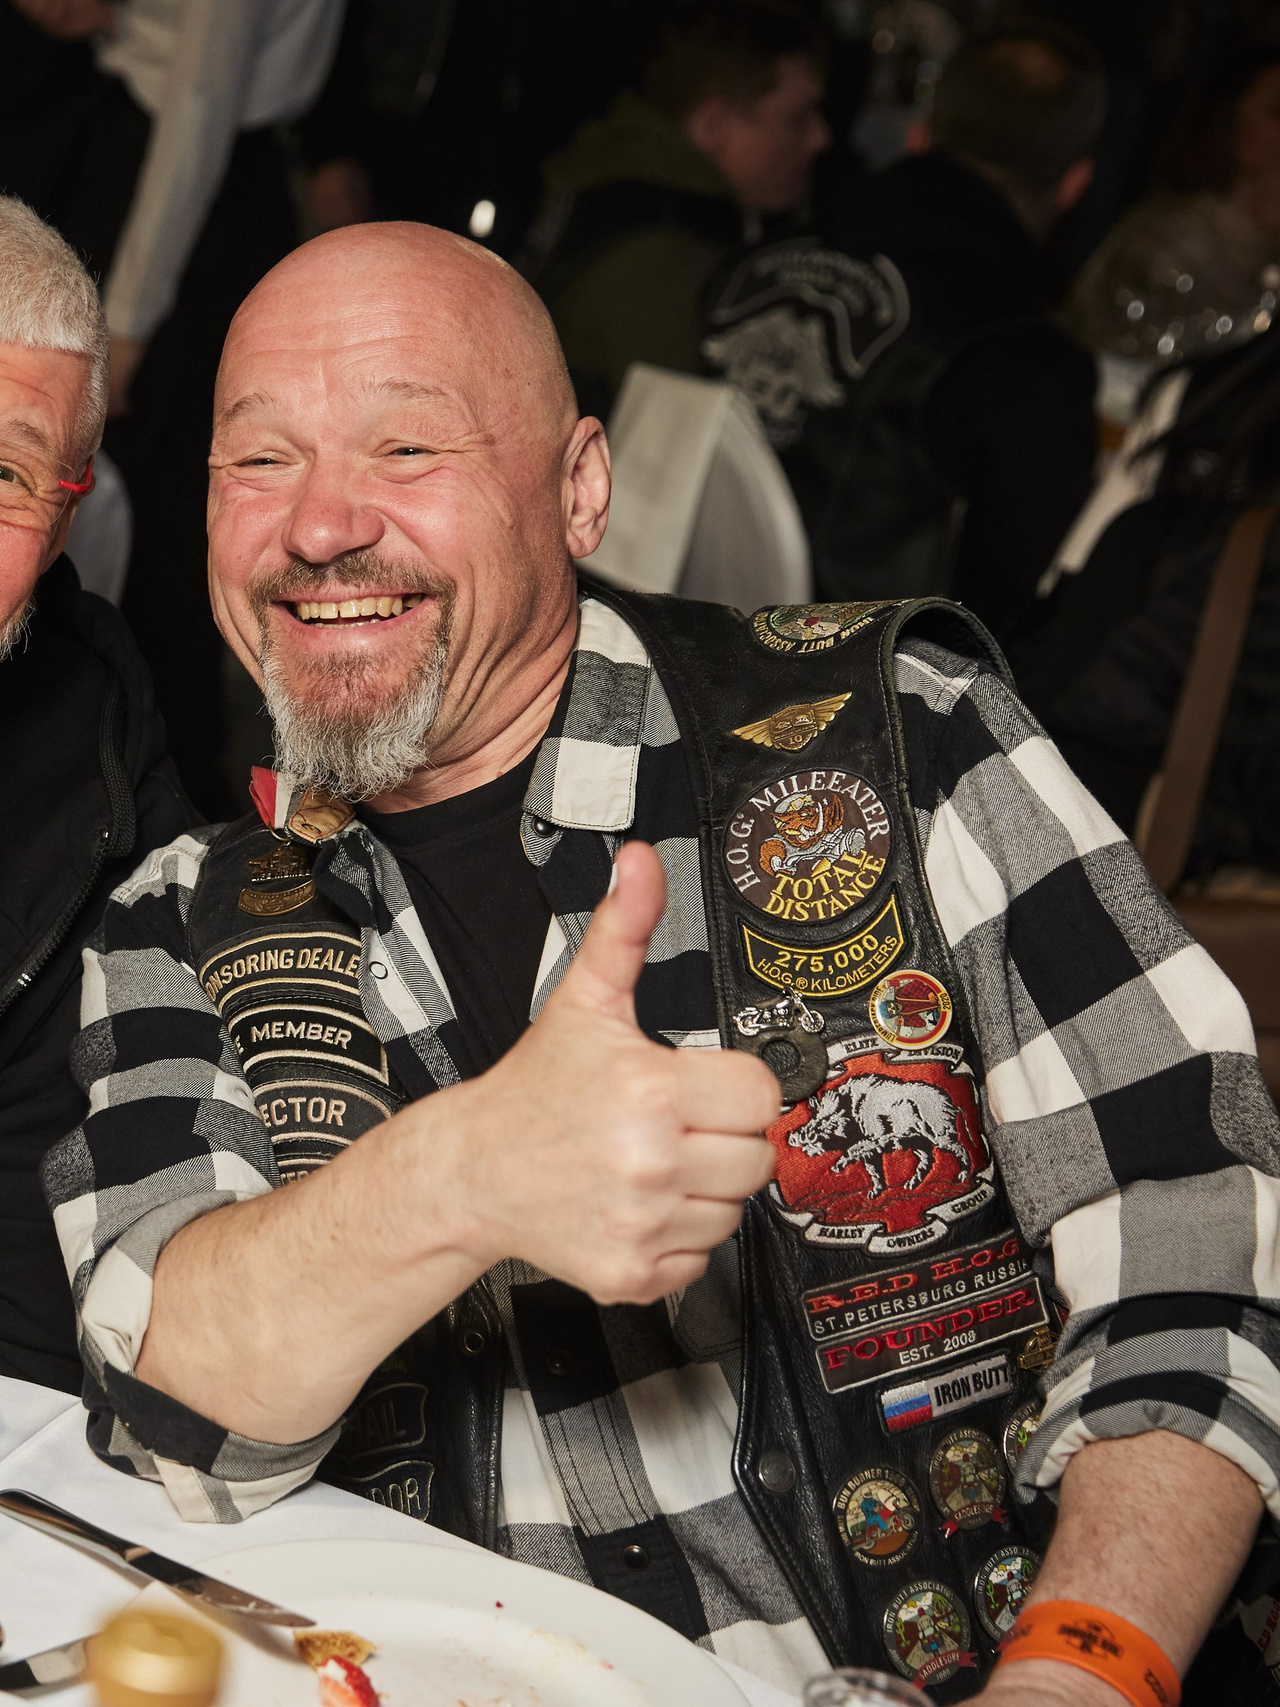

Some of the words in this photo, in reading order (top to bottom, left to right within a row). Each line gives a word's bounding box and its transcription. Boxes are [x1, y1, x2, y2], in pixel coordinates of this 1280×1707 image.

[797, 637, 834, 653] BUTT
[789, 734, 803, 745] 10
[749, 771, 890, 840] MILEEATER
[763, 855, 885, 921] DISTANCE
[770, 849, 867, 900] TOTAL
[296, 947, 360, 979] DEALE
[774, 934, 879, 974] 275,000
[811, 935, 897, 992] KILOMETERS
[939, 992, 951, 1010] 2020
[250, 1021, 352, 1050] MEMBER
[844, 1038, 879, 1053] ELITE
[817, 1227, 865, 1239] HARLEY
[886, 1227, 935, 1249] OWNERS
[950, 1189, 988, 1214] GROUP
[823, 1288, 1036, 1370] FOUNDER
[899, 1344, 934, 1366] EST.
[943, 1329, 977, 1352] 2008
[933, 1375, 972, 1407] IRON
[972, 1363, 1009, 1393] BUTT
[1008, 1419, 1020, 1439] IRON
[837, 1488, 851, 1509] BUN
[847, 1468, 882, 1490] BURNER
[886, 1611, 896, 1633] IRON
[893, 1590, 908, 1609] BUTT
[919, 1652, 960, 1680] SADDLESORE
